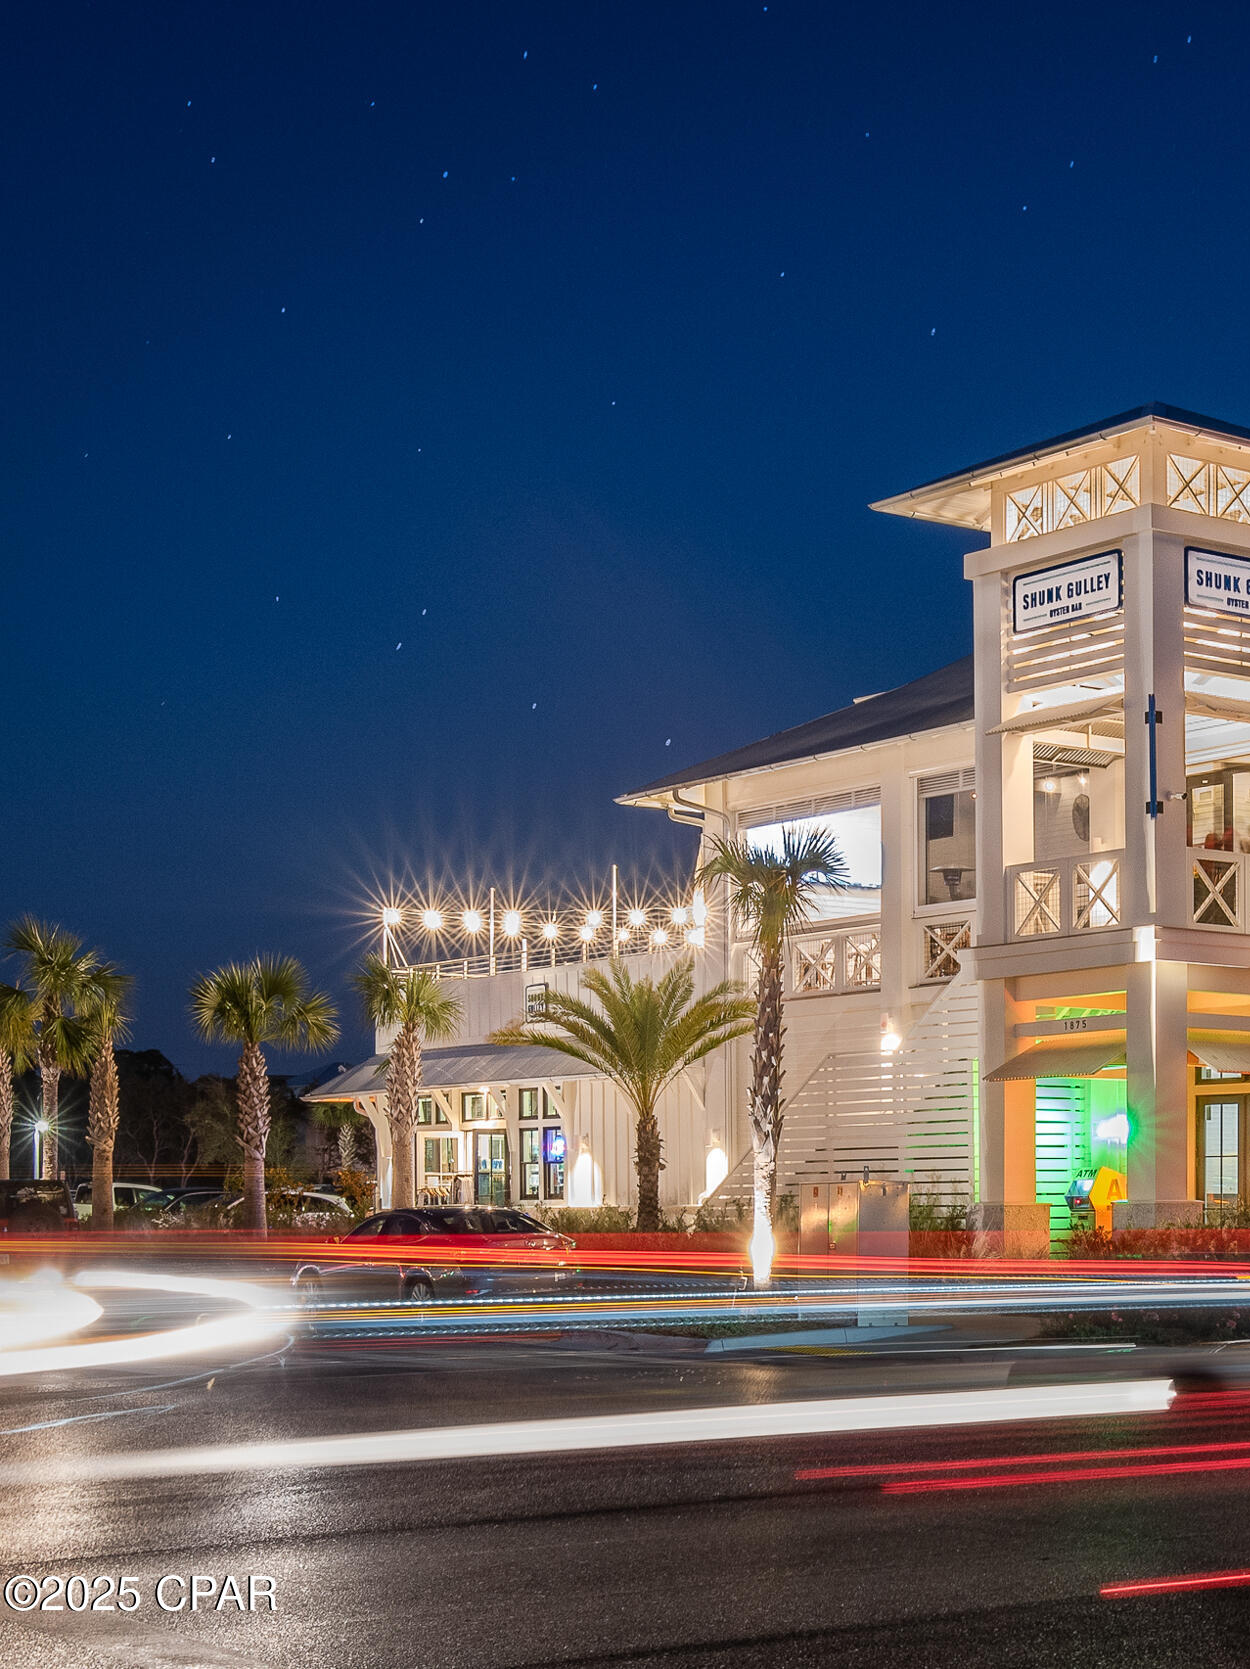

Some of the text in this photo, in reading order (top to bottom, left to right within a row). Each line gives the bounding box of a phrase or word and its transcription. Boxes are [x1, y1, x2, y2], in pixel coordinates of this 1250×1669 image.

[1196, 569, 1241, 593] SHUNK
[1023, 572, 1111, 610] SHUNK GULLEY
[1049, 602, 1082, 618] OYSTER BAR
[1226, 597, 1249, 609] OYSTER
[1064, 1019, 1087, 1031] 1875
[1075, 1169, 1098, 1178] ATM
